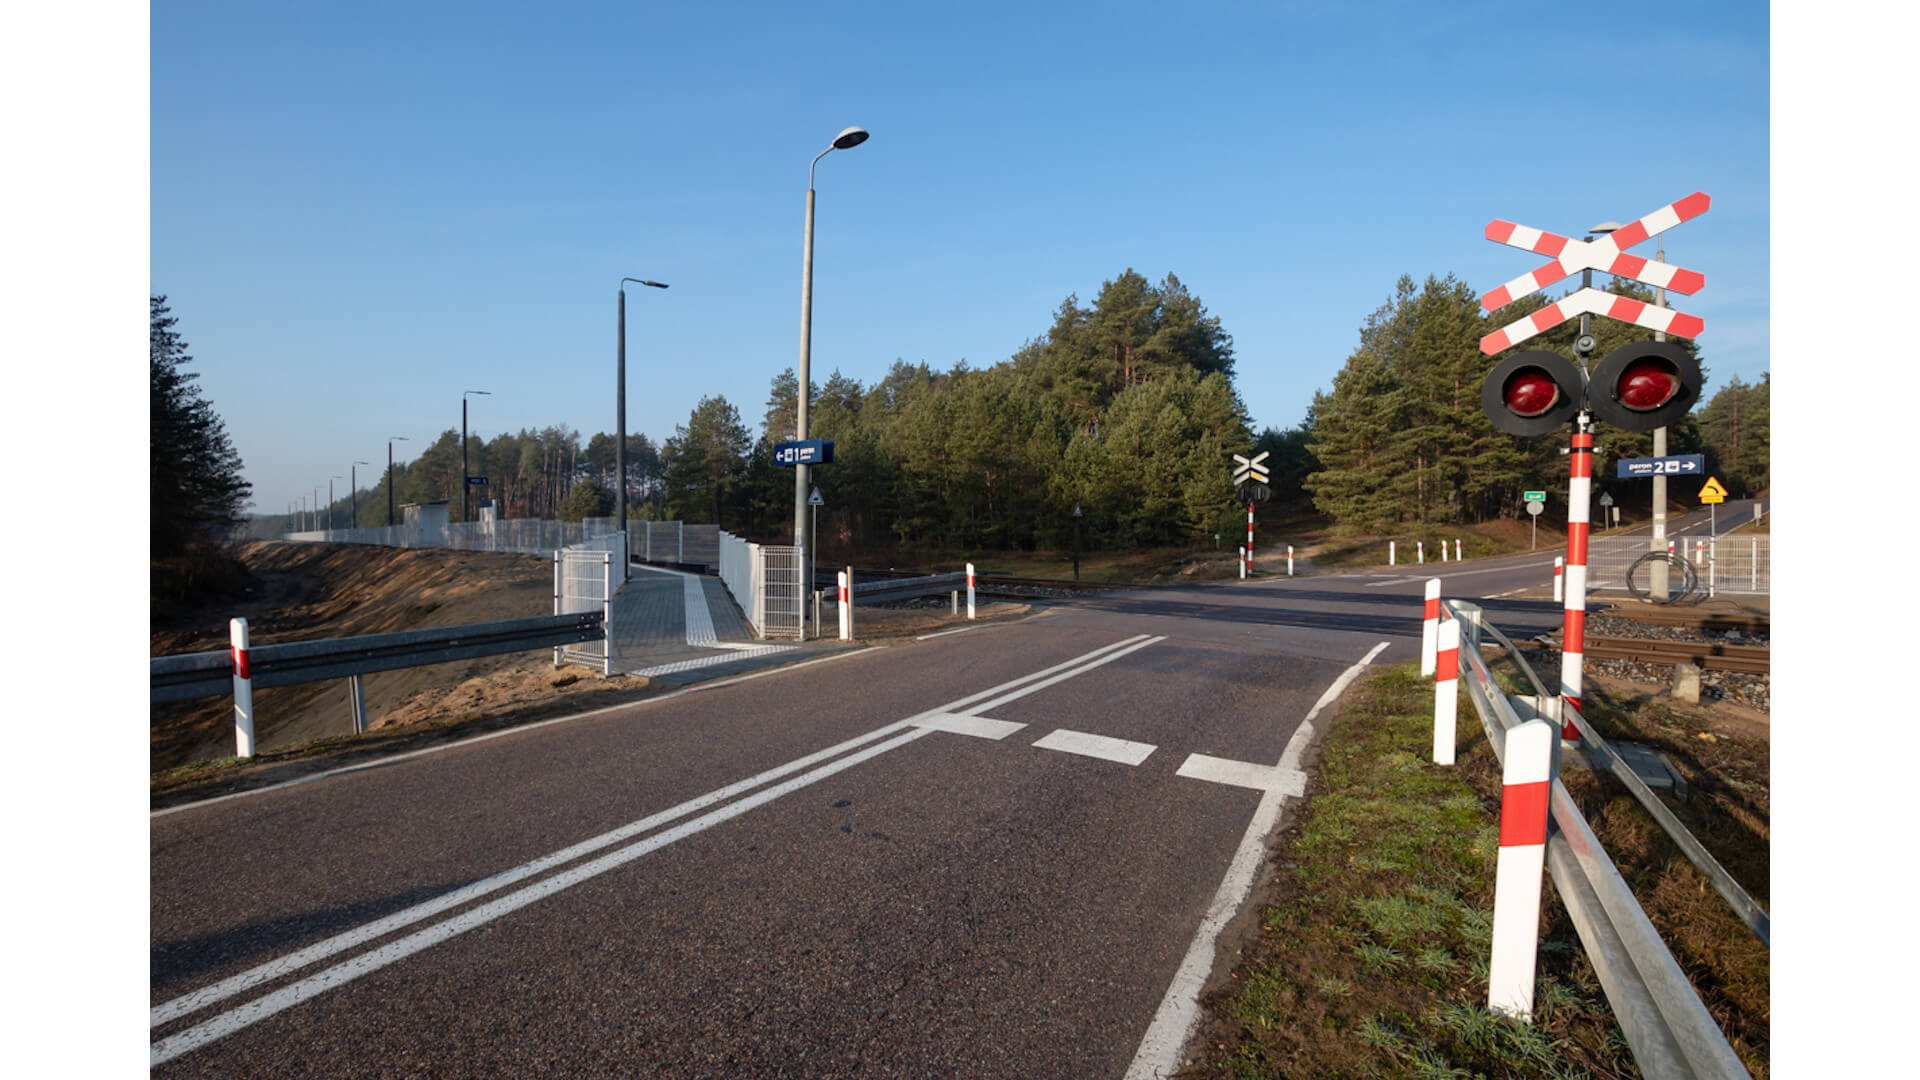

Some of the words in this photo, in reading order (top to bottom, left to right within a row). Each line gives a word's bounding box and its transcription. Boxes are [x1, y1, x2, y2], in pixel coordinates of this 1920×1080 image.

[794, 447, 799, 461] 1
[1628, 463, 1652, 471] peron
[1653, 461, 1665, 474] 2
